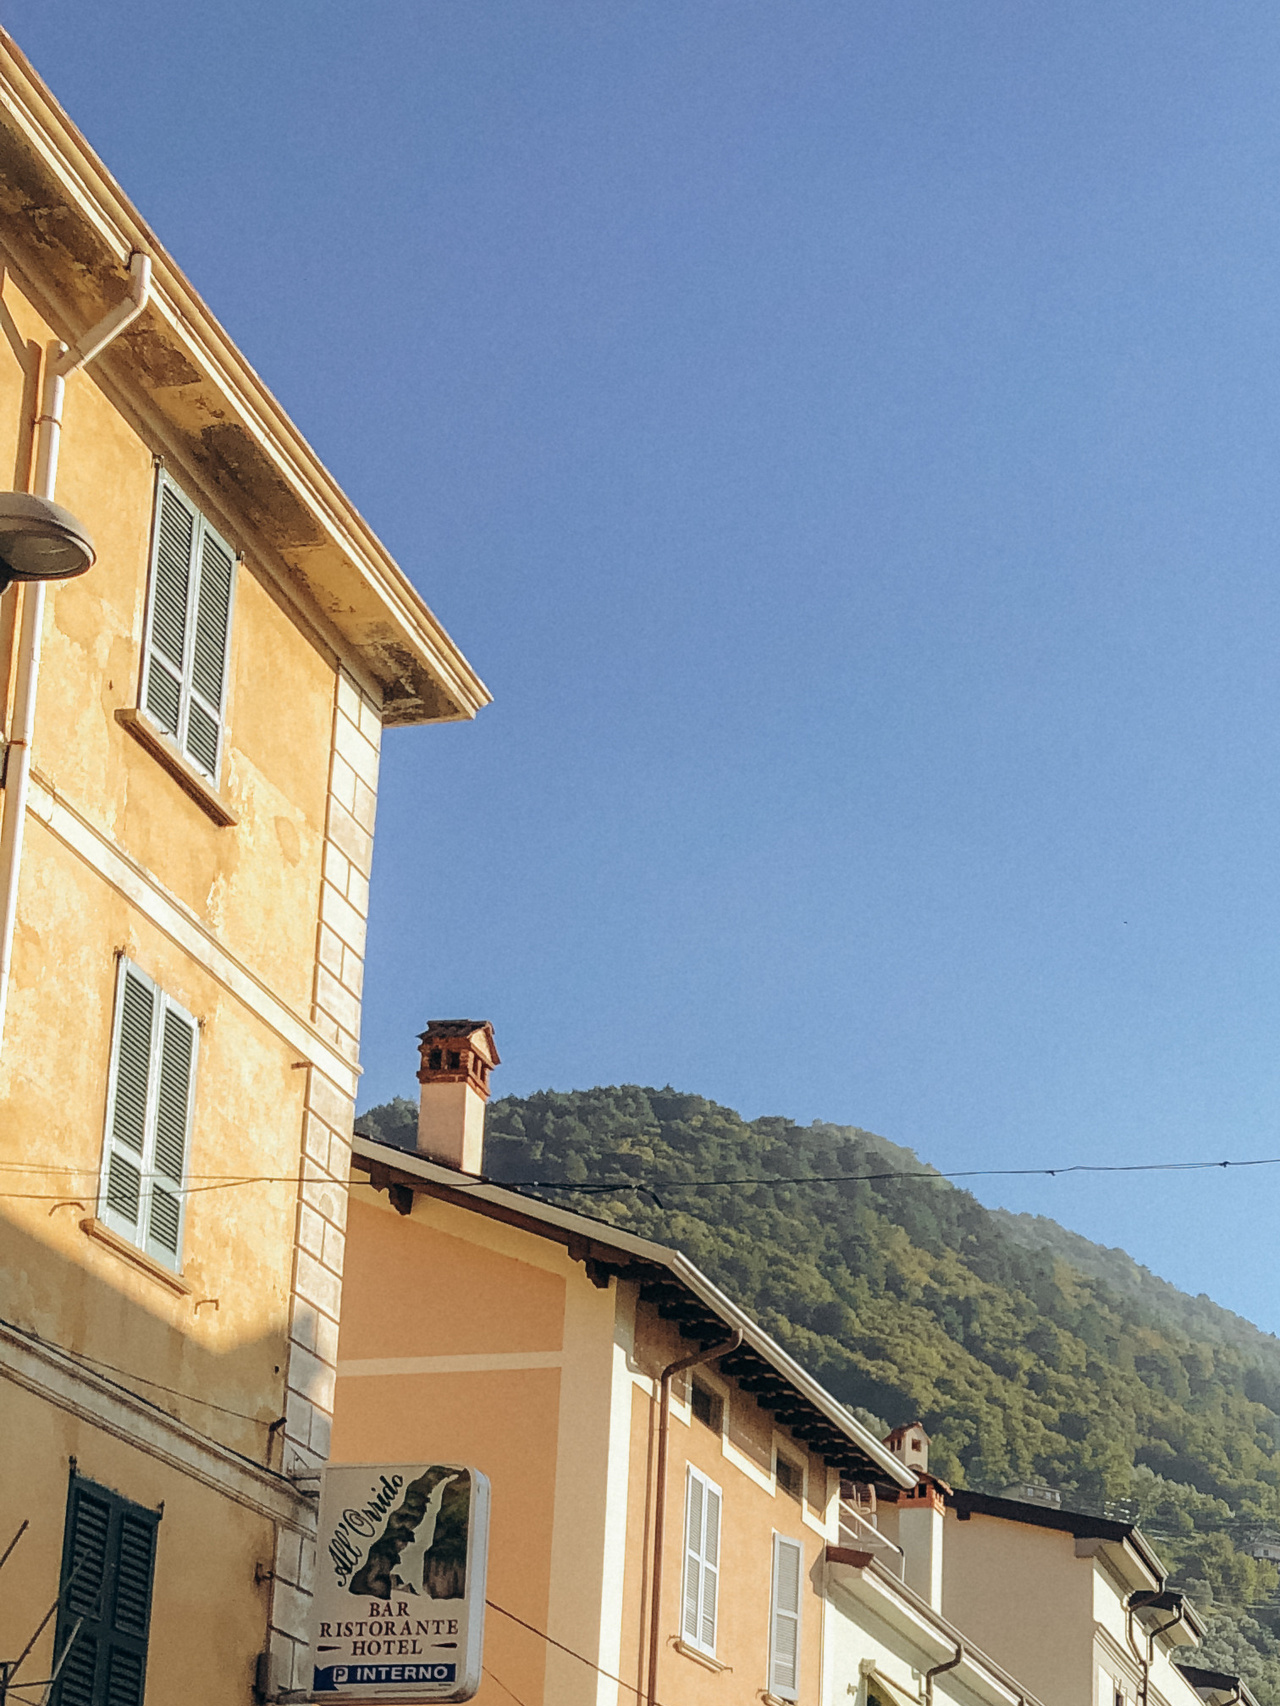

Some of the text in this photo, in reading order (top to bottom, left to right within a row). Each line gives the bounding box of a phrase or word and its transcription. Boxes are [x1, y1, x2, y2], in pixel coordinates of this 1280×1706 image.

[368, 1601, 411, 1618] BAR
[319, 1619, 459, 1638] RISTORANTE
[351, 1639, 423, 1656] HOTEL
[356, 1665, 448, 1681] INTERNO
